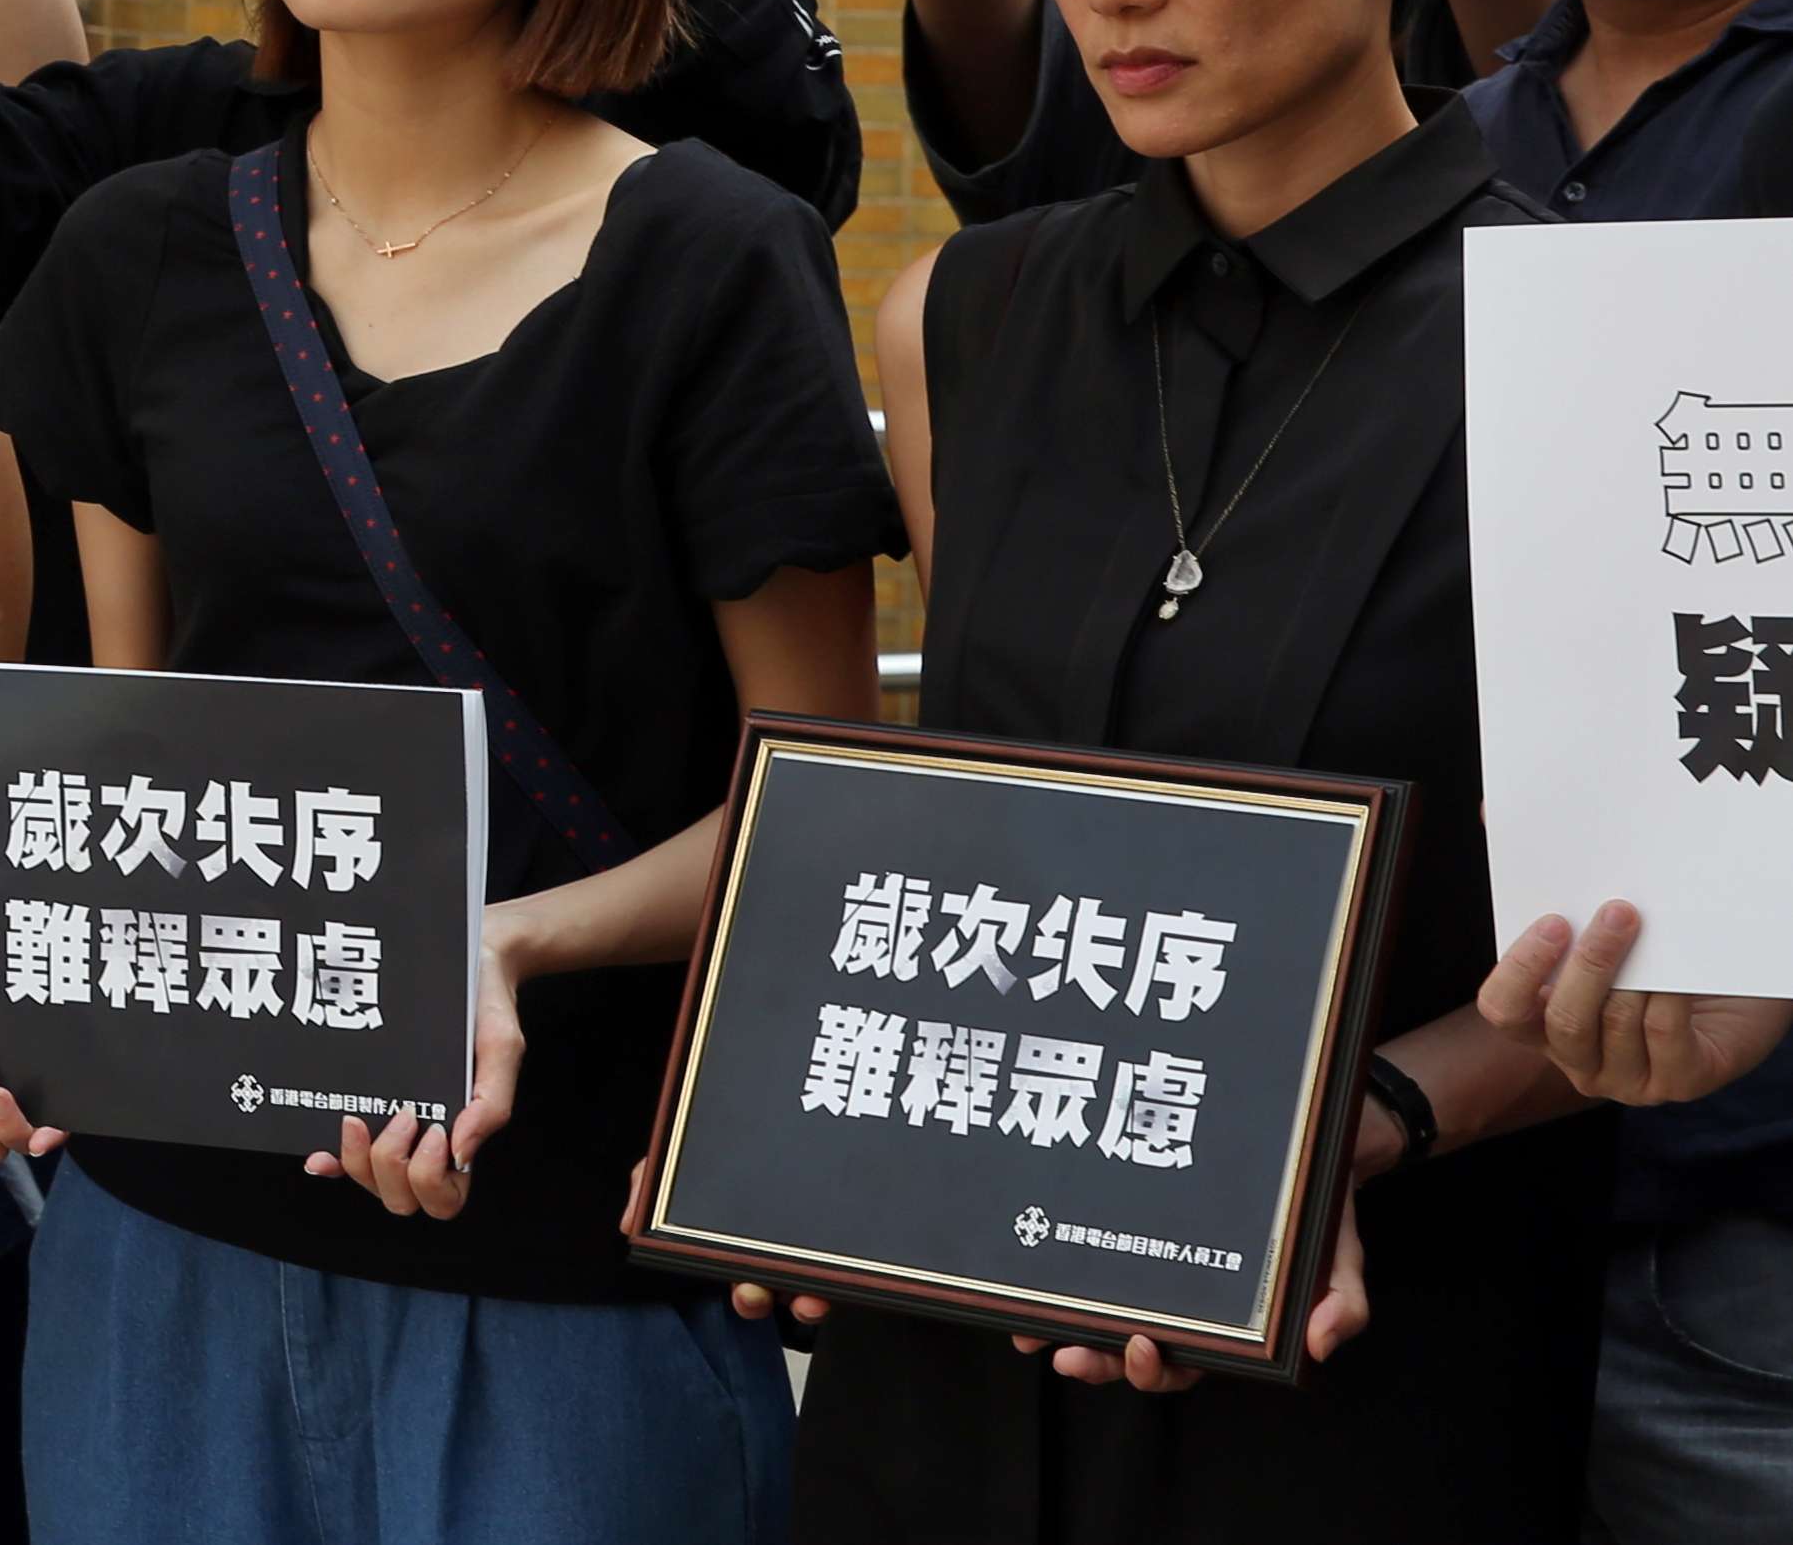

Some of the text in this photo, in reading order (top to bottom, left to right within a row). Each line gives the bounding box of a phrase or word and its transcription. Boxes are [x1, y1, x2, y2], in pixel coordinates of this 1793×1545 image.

[5, 768, 382, 892] 歲次失序
[4, 899, 383, 1030] 難釋眾慮
[829, 870, 1238, 1023] 歲次失序
[800, 1003, 1207, 1169] 難釋眾慮
[1054, 1221, 1243, 1272] 香港電台節目製作人員工會
